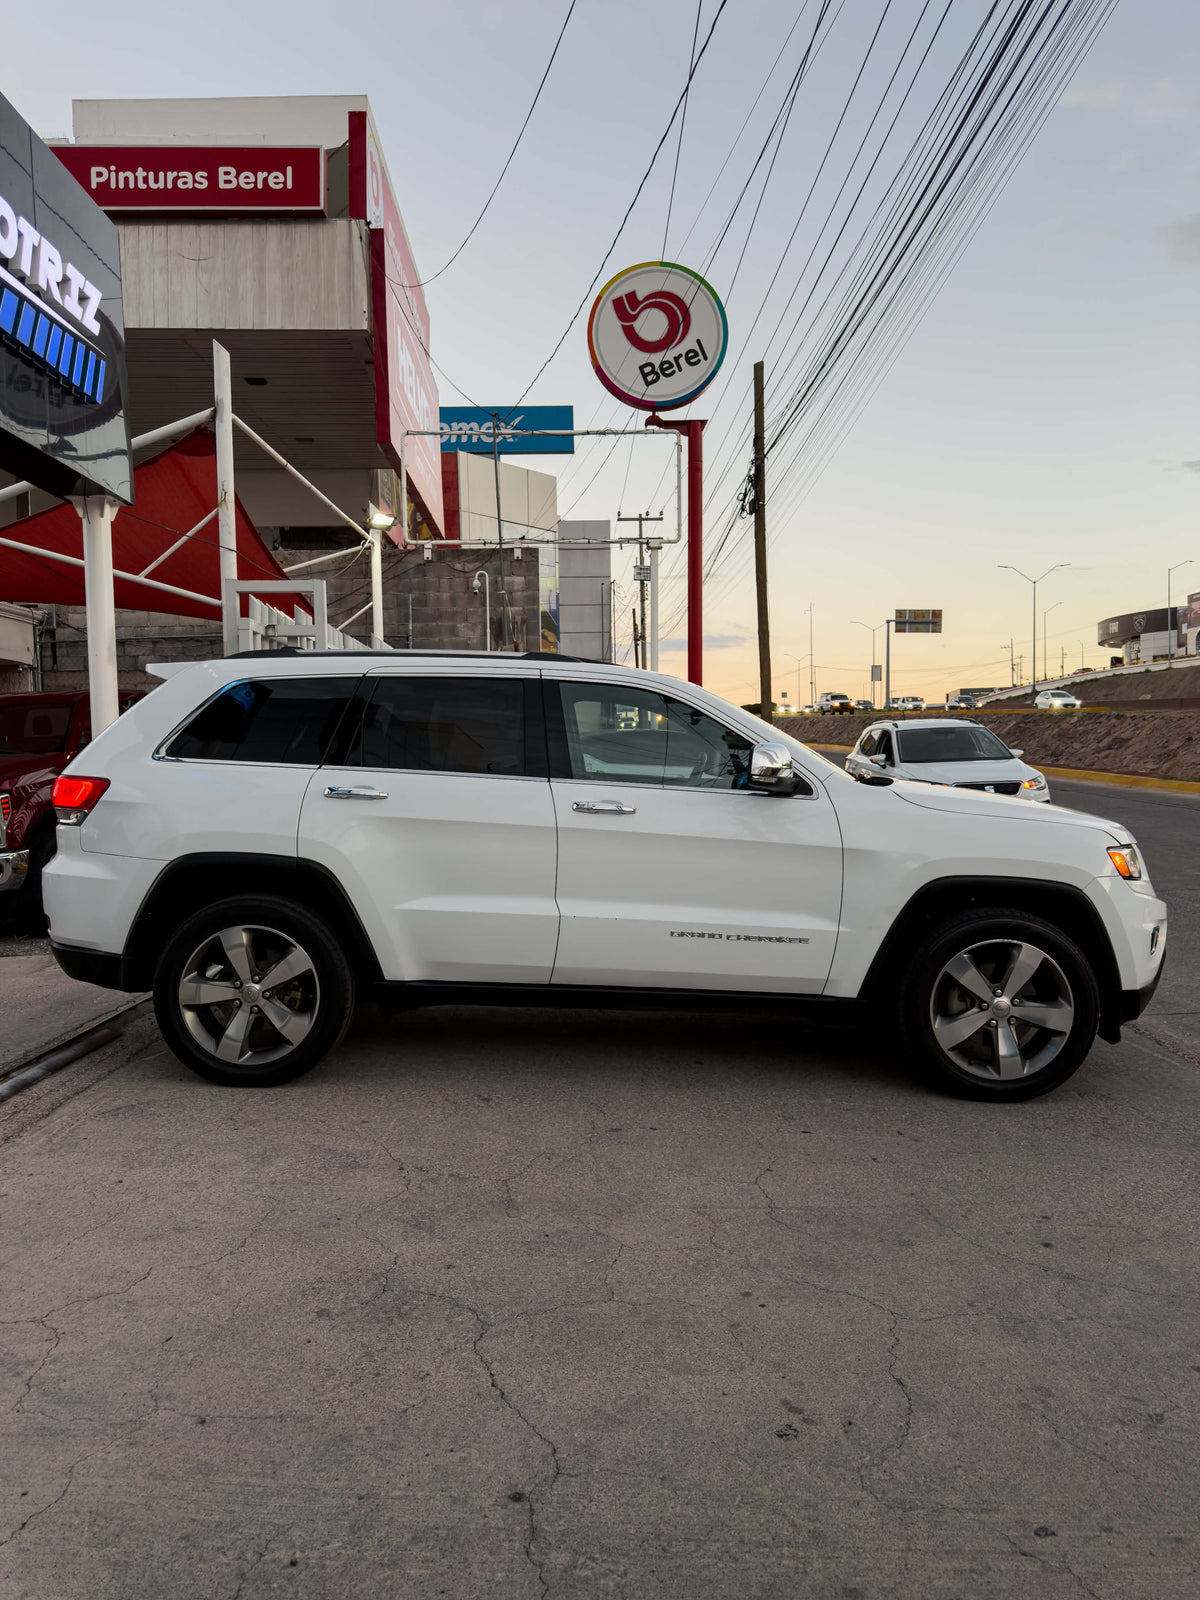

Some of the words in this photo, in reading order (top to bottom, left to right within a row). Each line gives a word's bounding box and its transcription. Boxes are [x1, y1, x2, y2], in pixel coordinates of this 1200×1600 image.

[90, 165, 209, 190] Pinturas
[218, 165, 293, 190] Berel
[638, 338, 708, 388] Berel
[670, 931, 722, 939] GRAND
[726, 934, 809, 944] CHEROKEE
